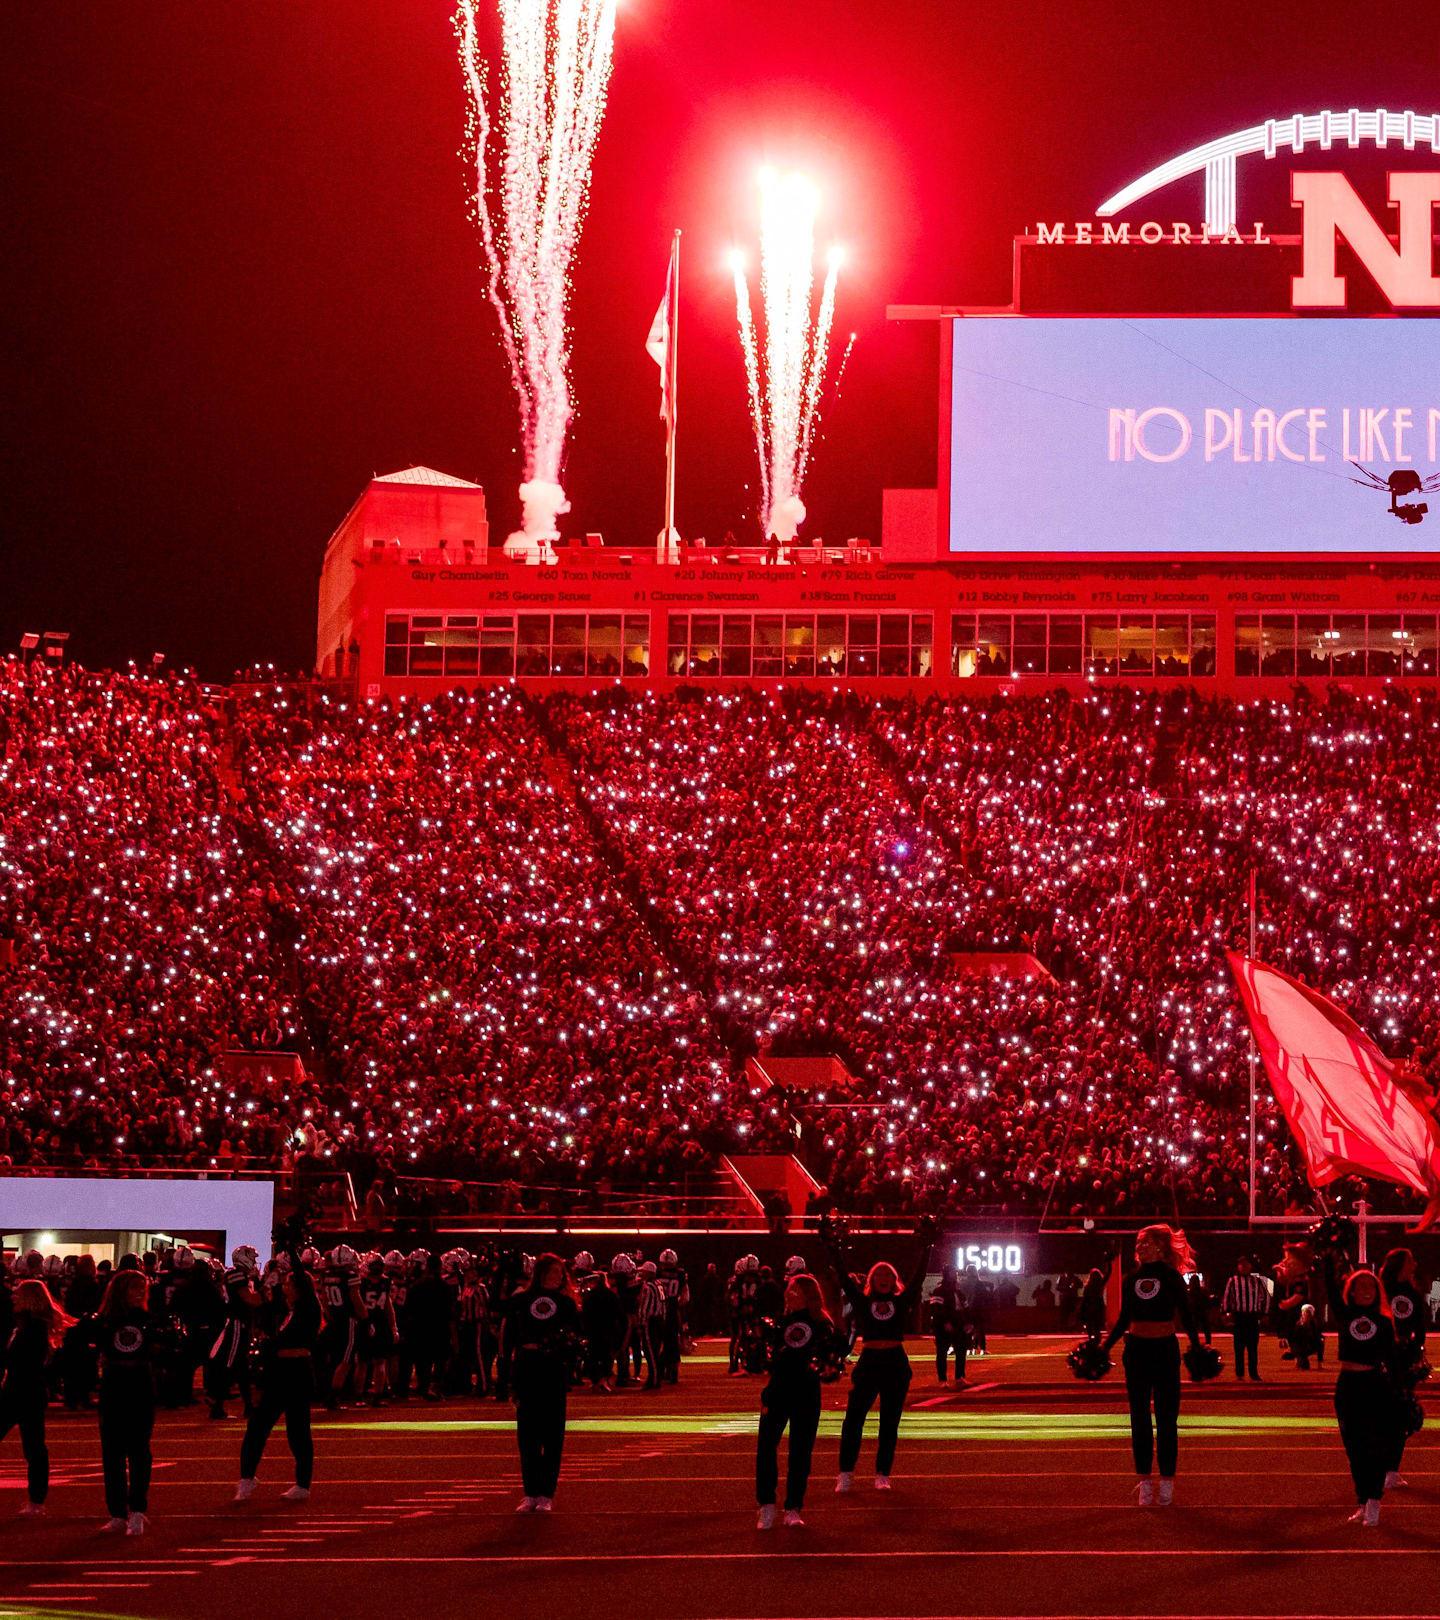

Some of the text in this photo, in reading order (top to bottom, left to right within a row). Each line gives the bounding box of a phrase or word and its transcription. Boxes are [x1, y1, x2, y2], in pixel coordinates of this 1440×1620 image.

[1036, 221, 1272, 245] MEMORIAL
[1108, 405, 1192, 463] NO
[1203, 405, 1327, 463] PLACE
[1343, 405, 1413, 463] LIKE
[411, 570, 510, 583] Guy Chamberlin
[957, 1246, 1021, 1271] 15:00
[365, 1291, 387, 1309] 54
